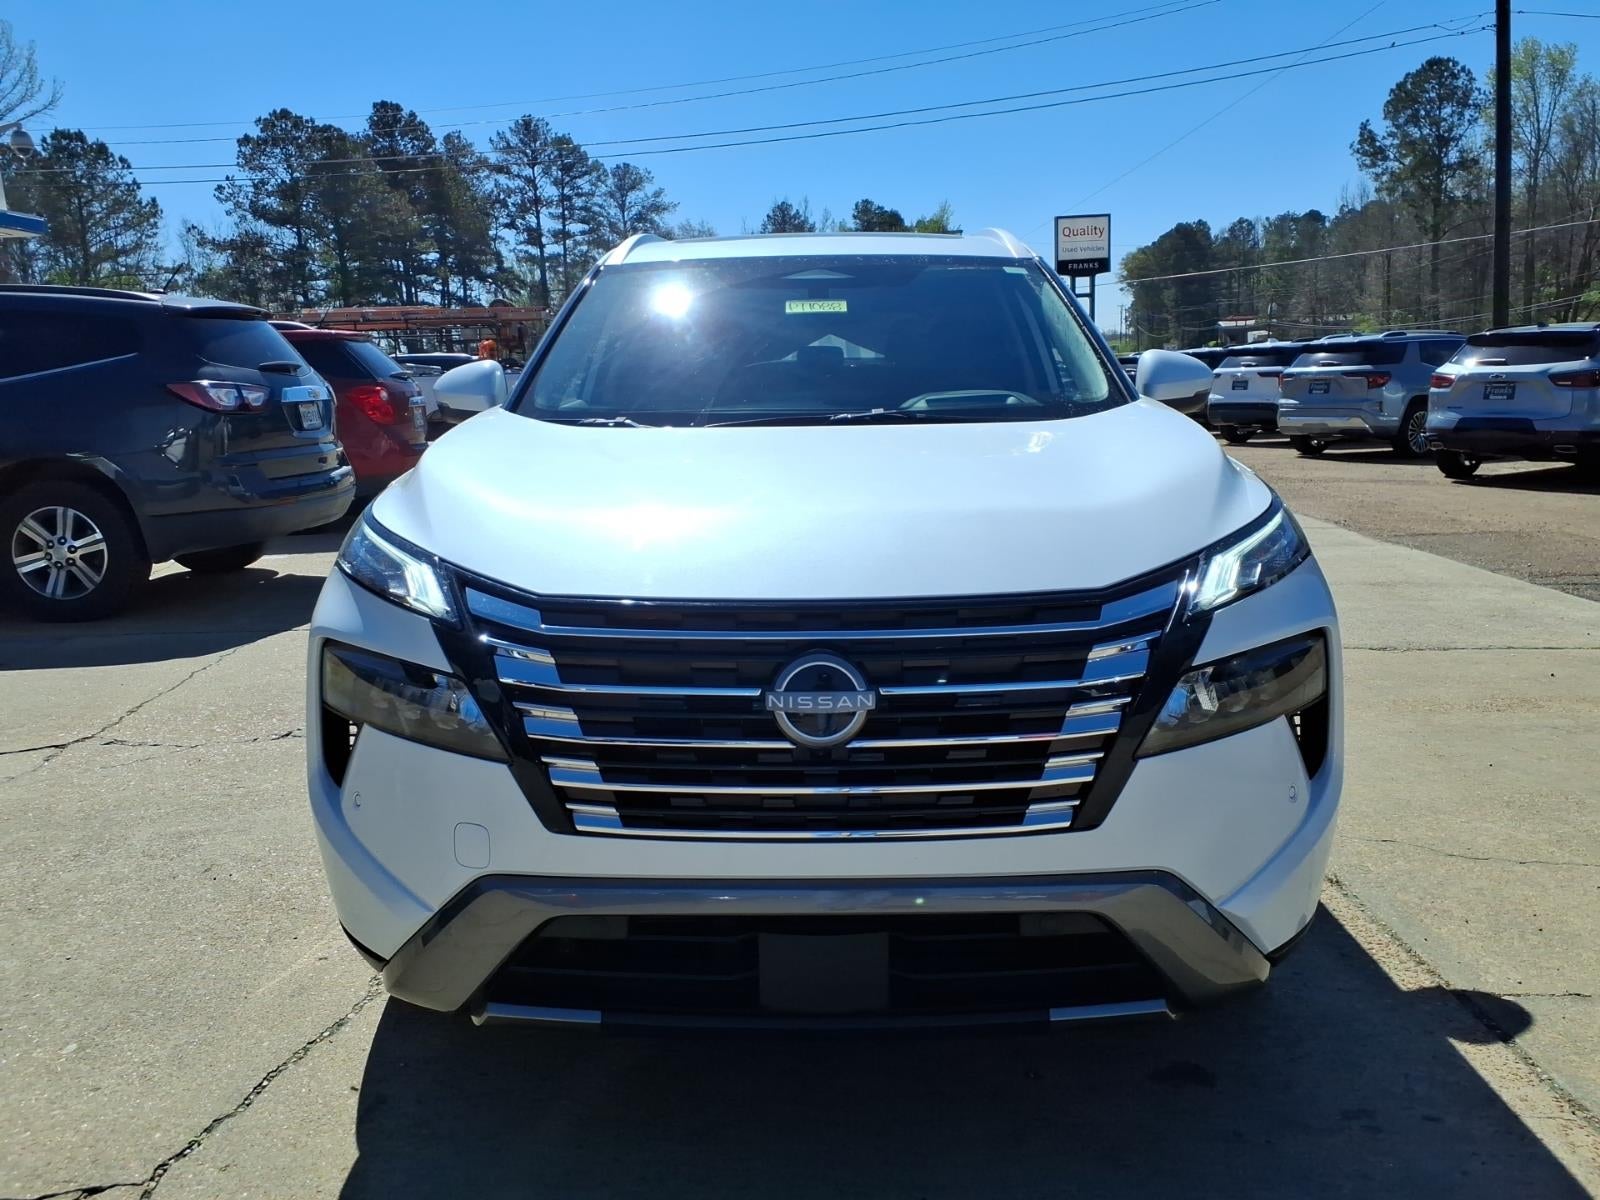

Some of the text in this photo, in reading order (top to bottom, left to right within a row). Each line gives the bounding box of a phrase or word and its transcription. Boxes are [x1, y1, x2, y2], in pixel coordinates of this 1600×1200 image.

[1062, 225, 1105, 239] Quality
[1068, 262, 1100, 270] FRANKS
[768, 694, 873, 709] NISSAN
